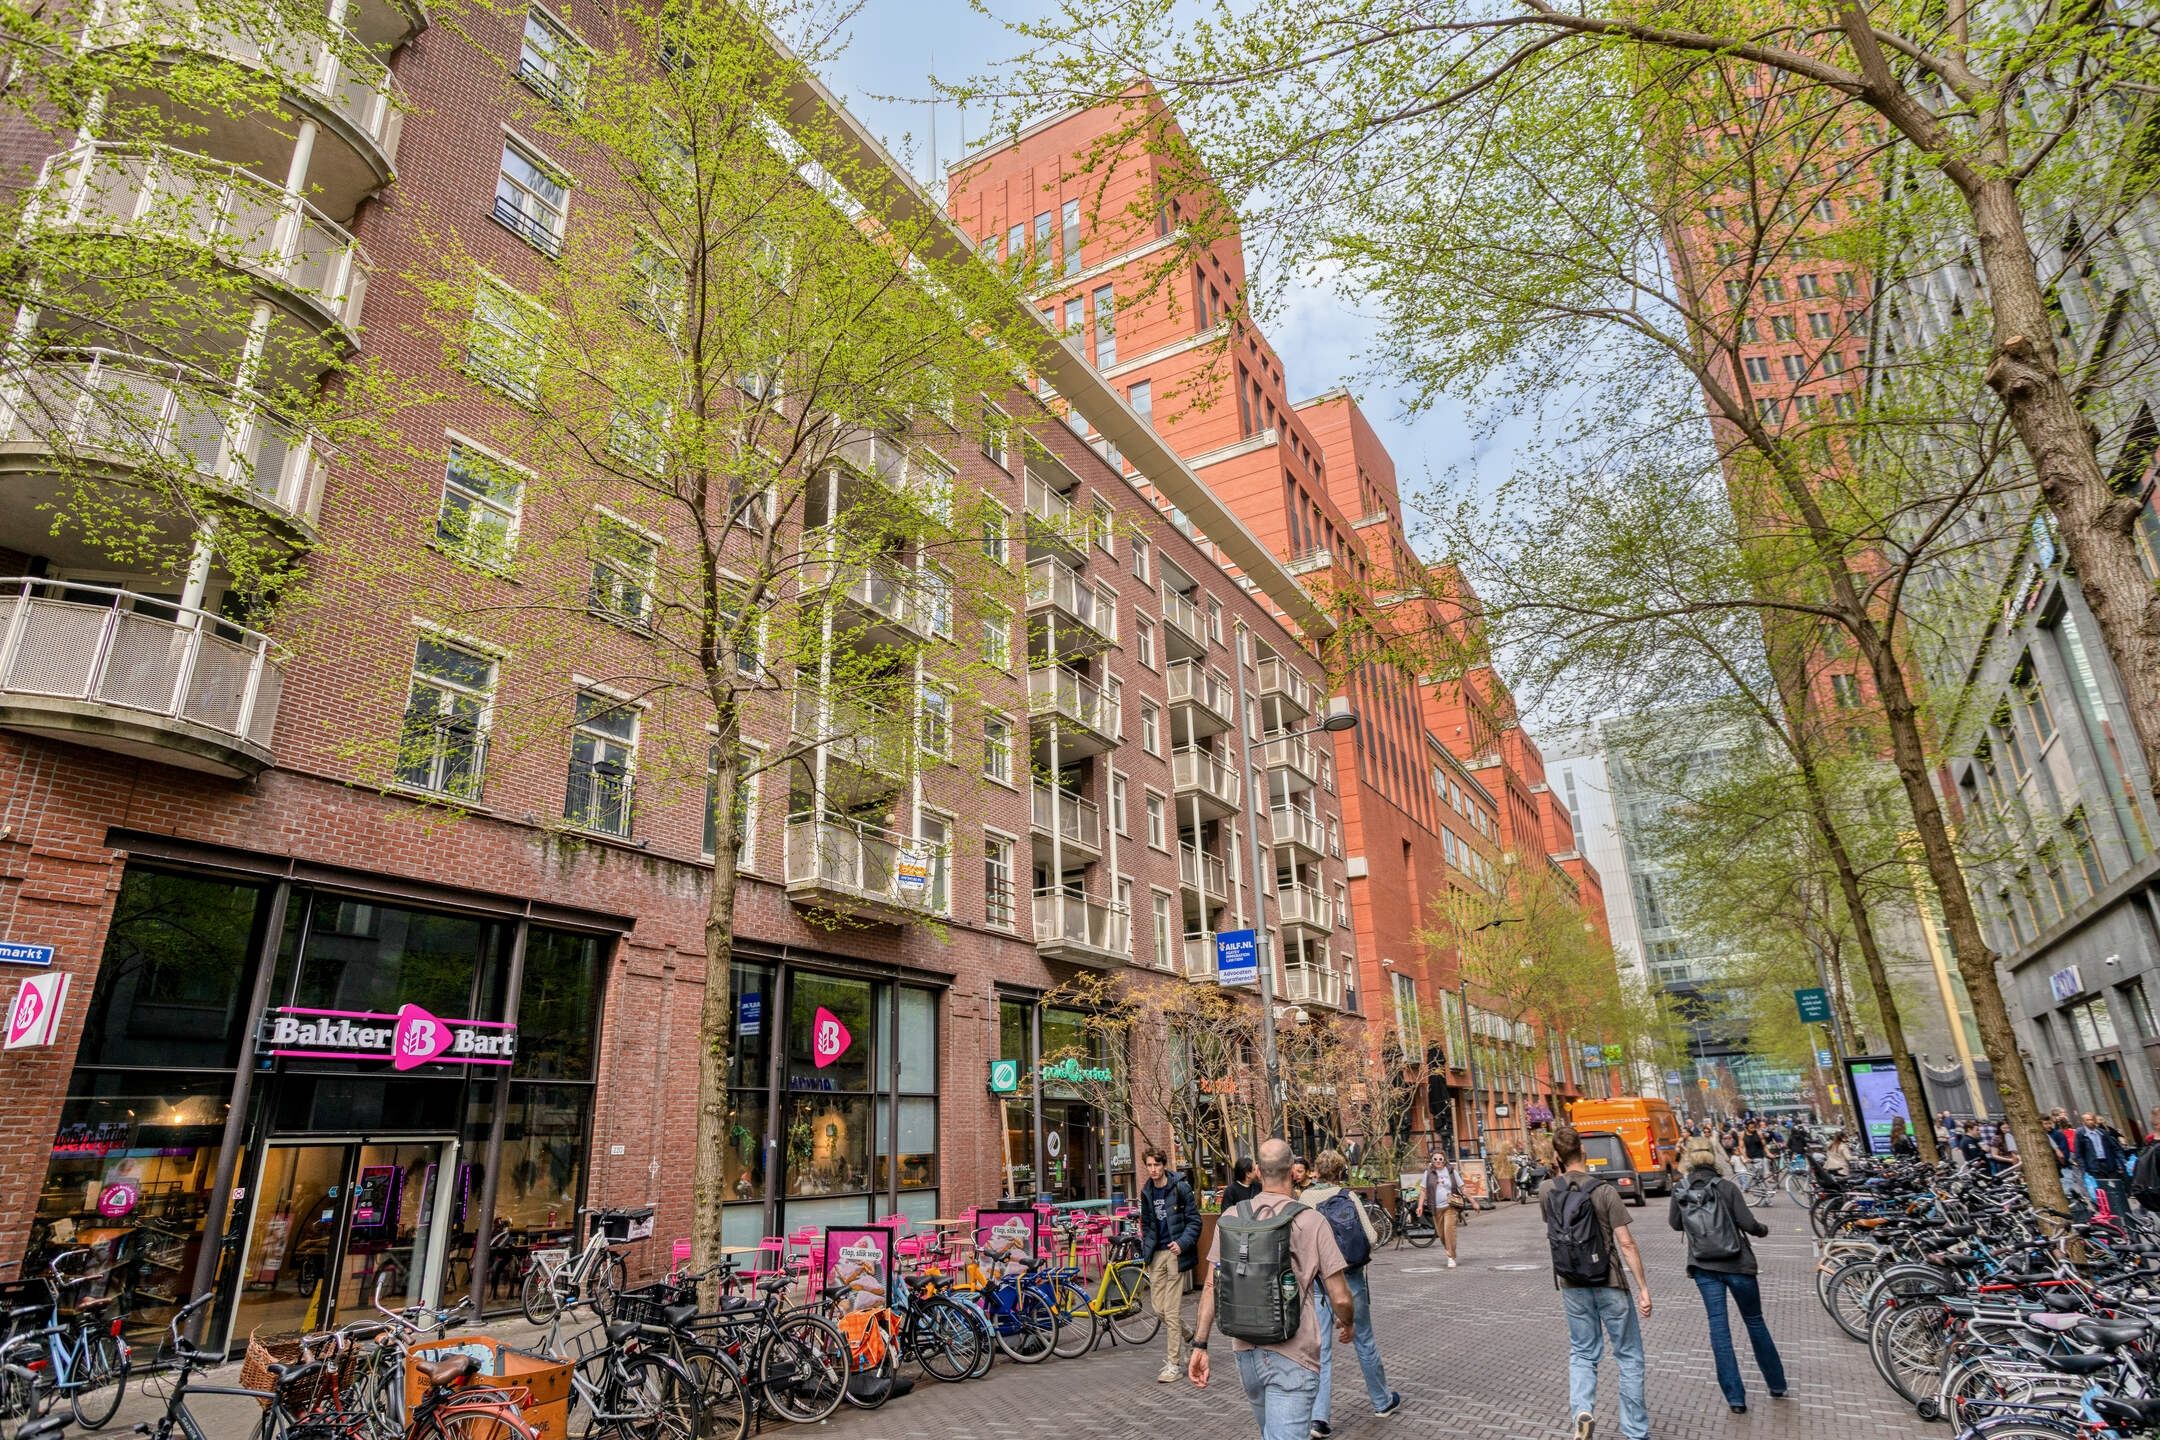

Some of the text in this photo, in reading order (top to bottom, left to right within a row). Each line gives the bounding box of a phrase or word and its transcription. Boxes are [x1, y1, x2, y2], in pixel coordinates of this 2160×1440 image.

[1226, 941, 1253, 950] AILF.NL
[0, 948, 42, 959] markt
[1223, 969, 1252, 977] Advocaten
[271, 1017, 393, 1049] Bakker
[453, 1029, 513, 1055] Bart
